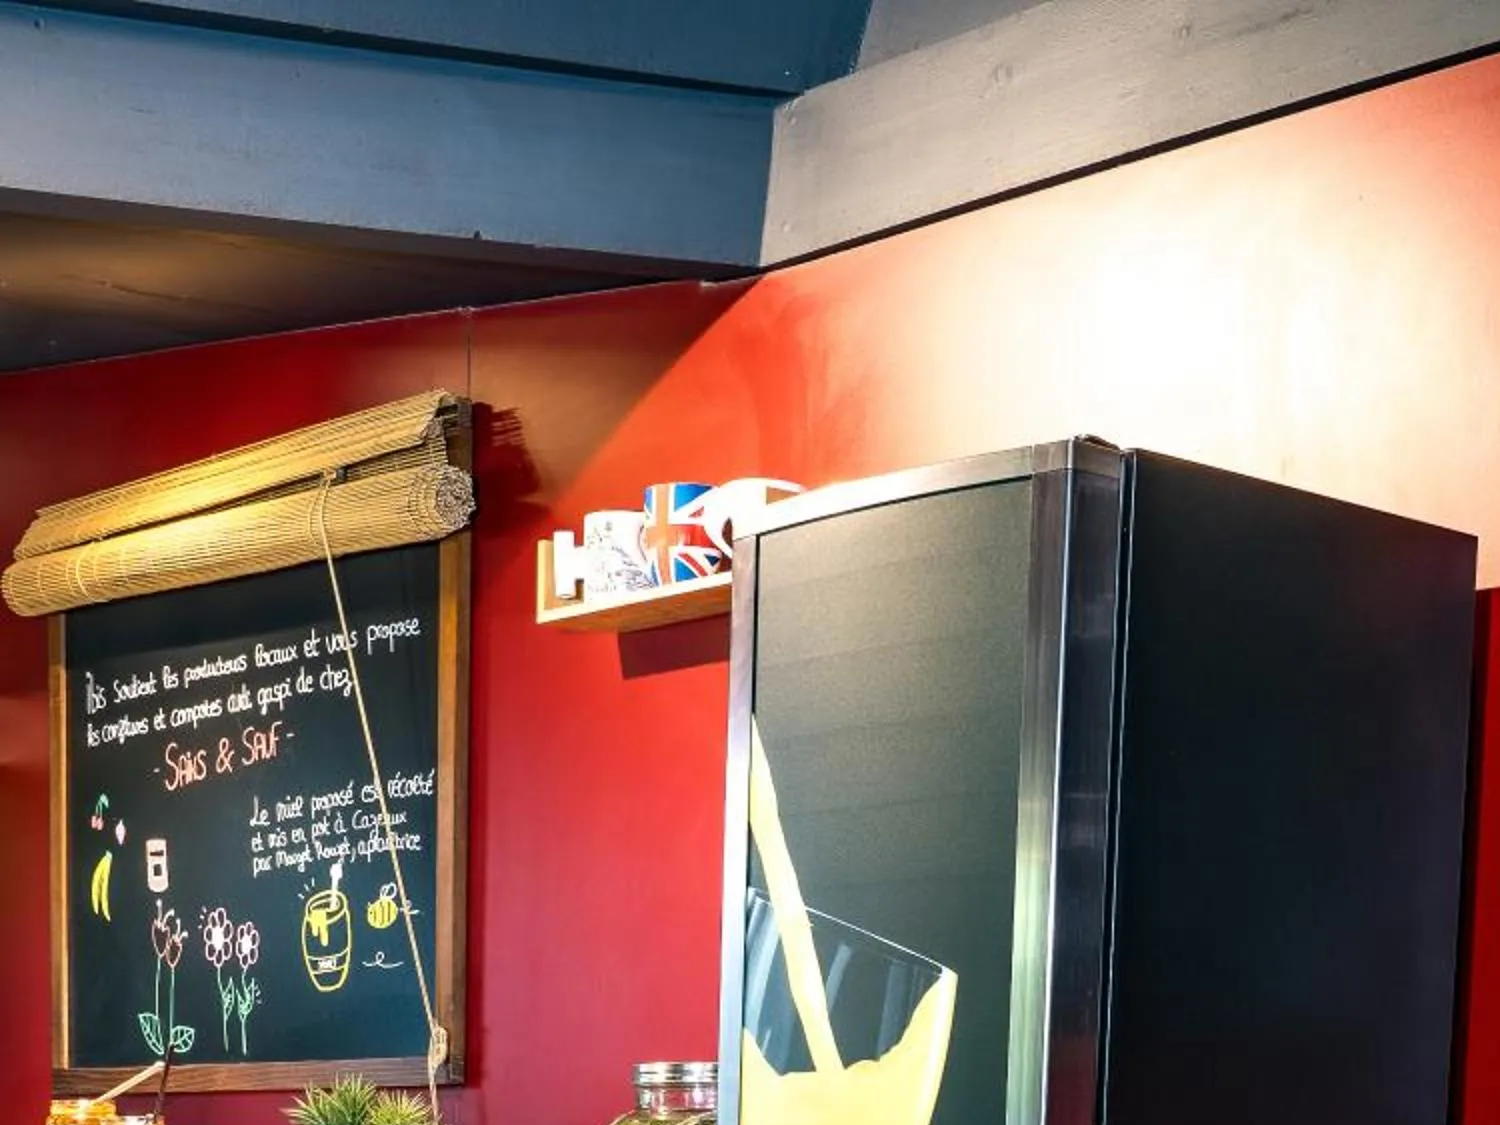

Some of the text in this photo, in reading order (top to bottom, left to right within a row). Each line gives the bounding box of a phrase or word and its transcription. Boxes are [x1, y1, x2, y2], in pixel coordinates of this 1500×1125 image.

[303, 627, 321, 658] et
[366, 617, 422, 656] propose
[153, 707, 167, 731] et
[257, 677, 293, 715] gaspi
[295, 664, 315, 694] de
[318, 663, 353, 698] chez
[215, 736, 236, 775] &
[249, 795, 271, 827] Le
[275, 794, 305, 823] miel
[361, 784, 384, 804] es
[251, 831, 265, 853] et
